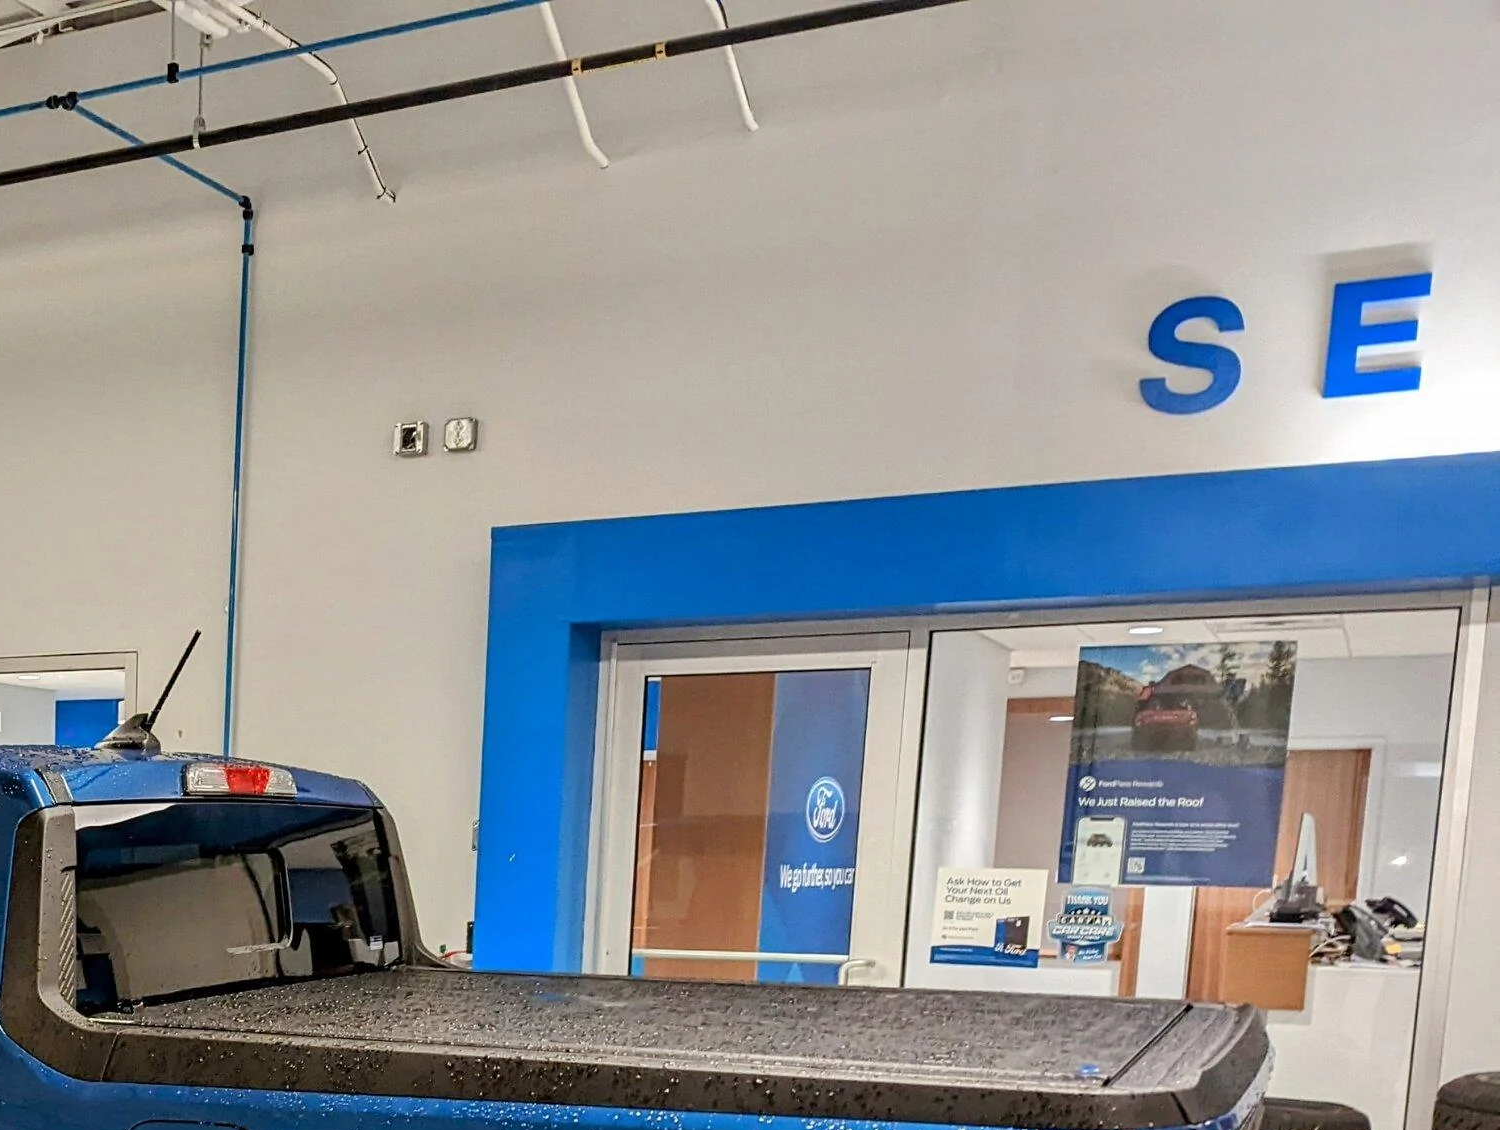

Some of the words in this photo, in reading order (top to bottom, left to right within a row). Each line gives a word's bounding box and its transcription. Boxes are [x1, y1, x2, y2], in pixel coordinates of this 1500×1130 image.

[1078, 796, 1096, 808] We
[1097, 796, 1118, 808] Just
[1120, 796, 1156, 808] Raised
[1158, 797, 1176, 808] the
[1177, 796, 1205, 808] Roof
[779, 864, 792, 889] We
[946, 876, 965, 886] Ask
[967, 877, 989, 887] How
[992, 878, 1002, 887] to
[1003, 879, 1022, 888] Get
[947, 886, 967, 895] Your
[970, 887, 993, 895] Next
[945, 895, 982, 905] Change
[983, 896, 997, 905] on
[998, 896, 1012, 906] Us
[1093, 895, 1109, 906] YOU
